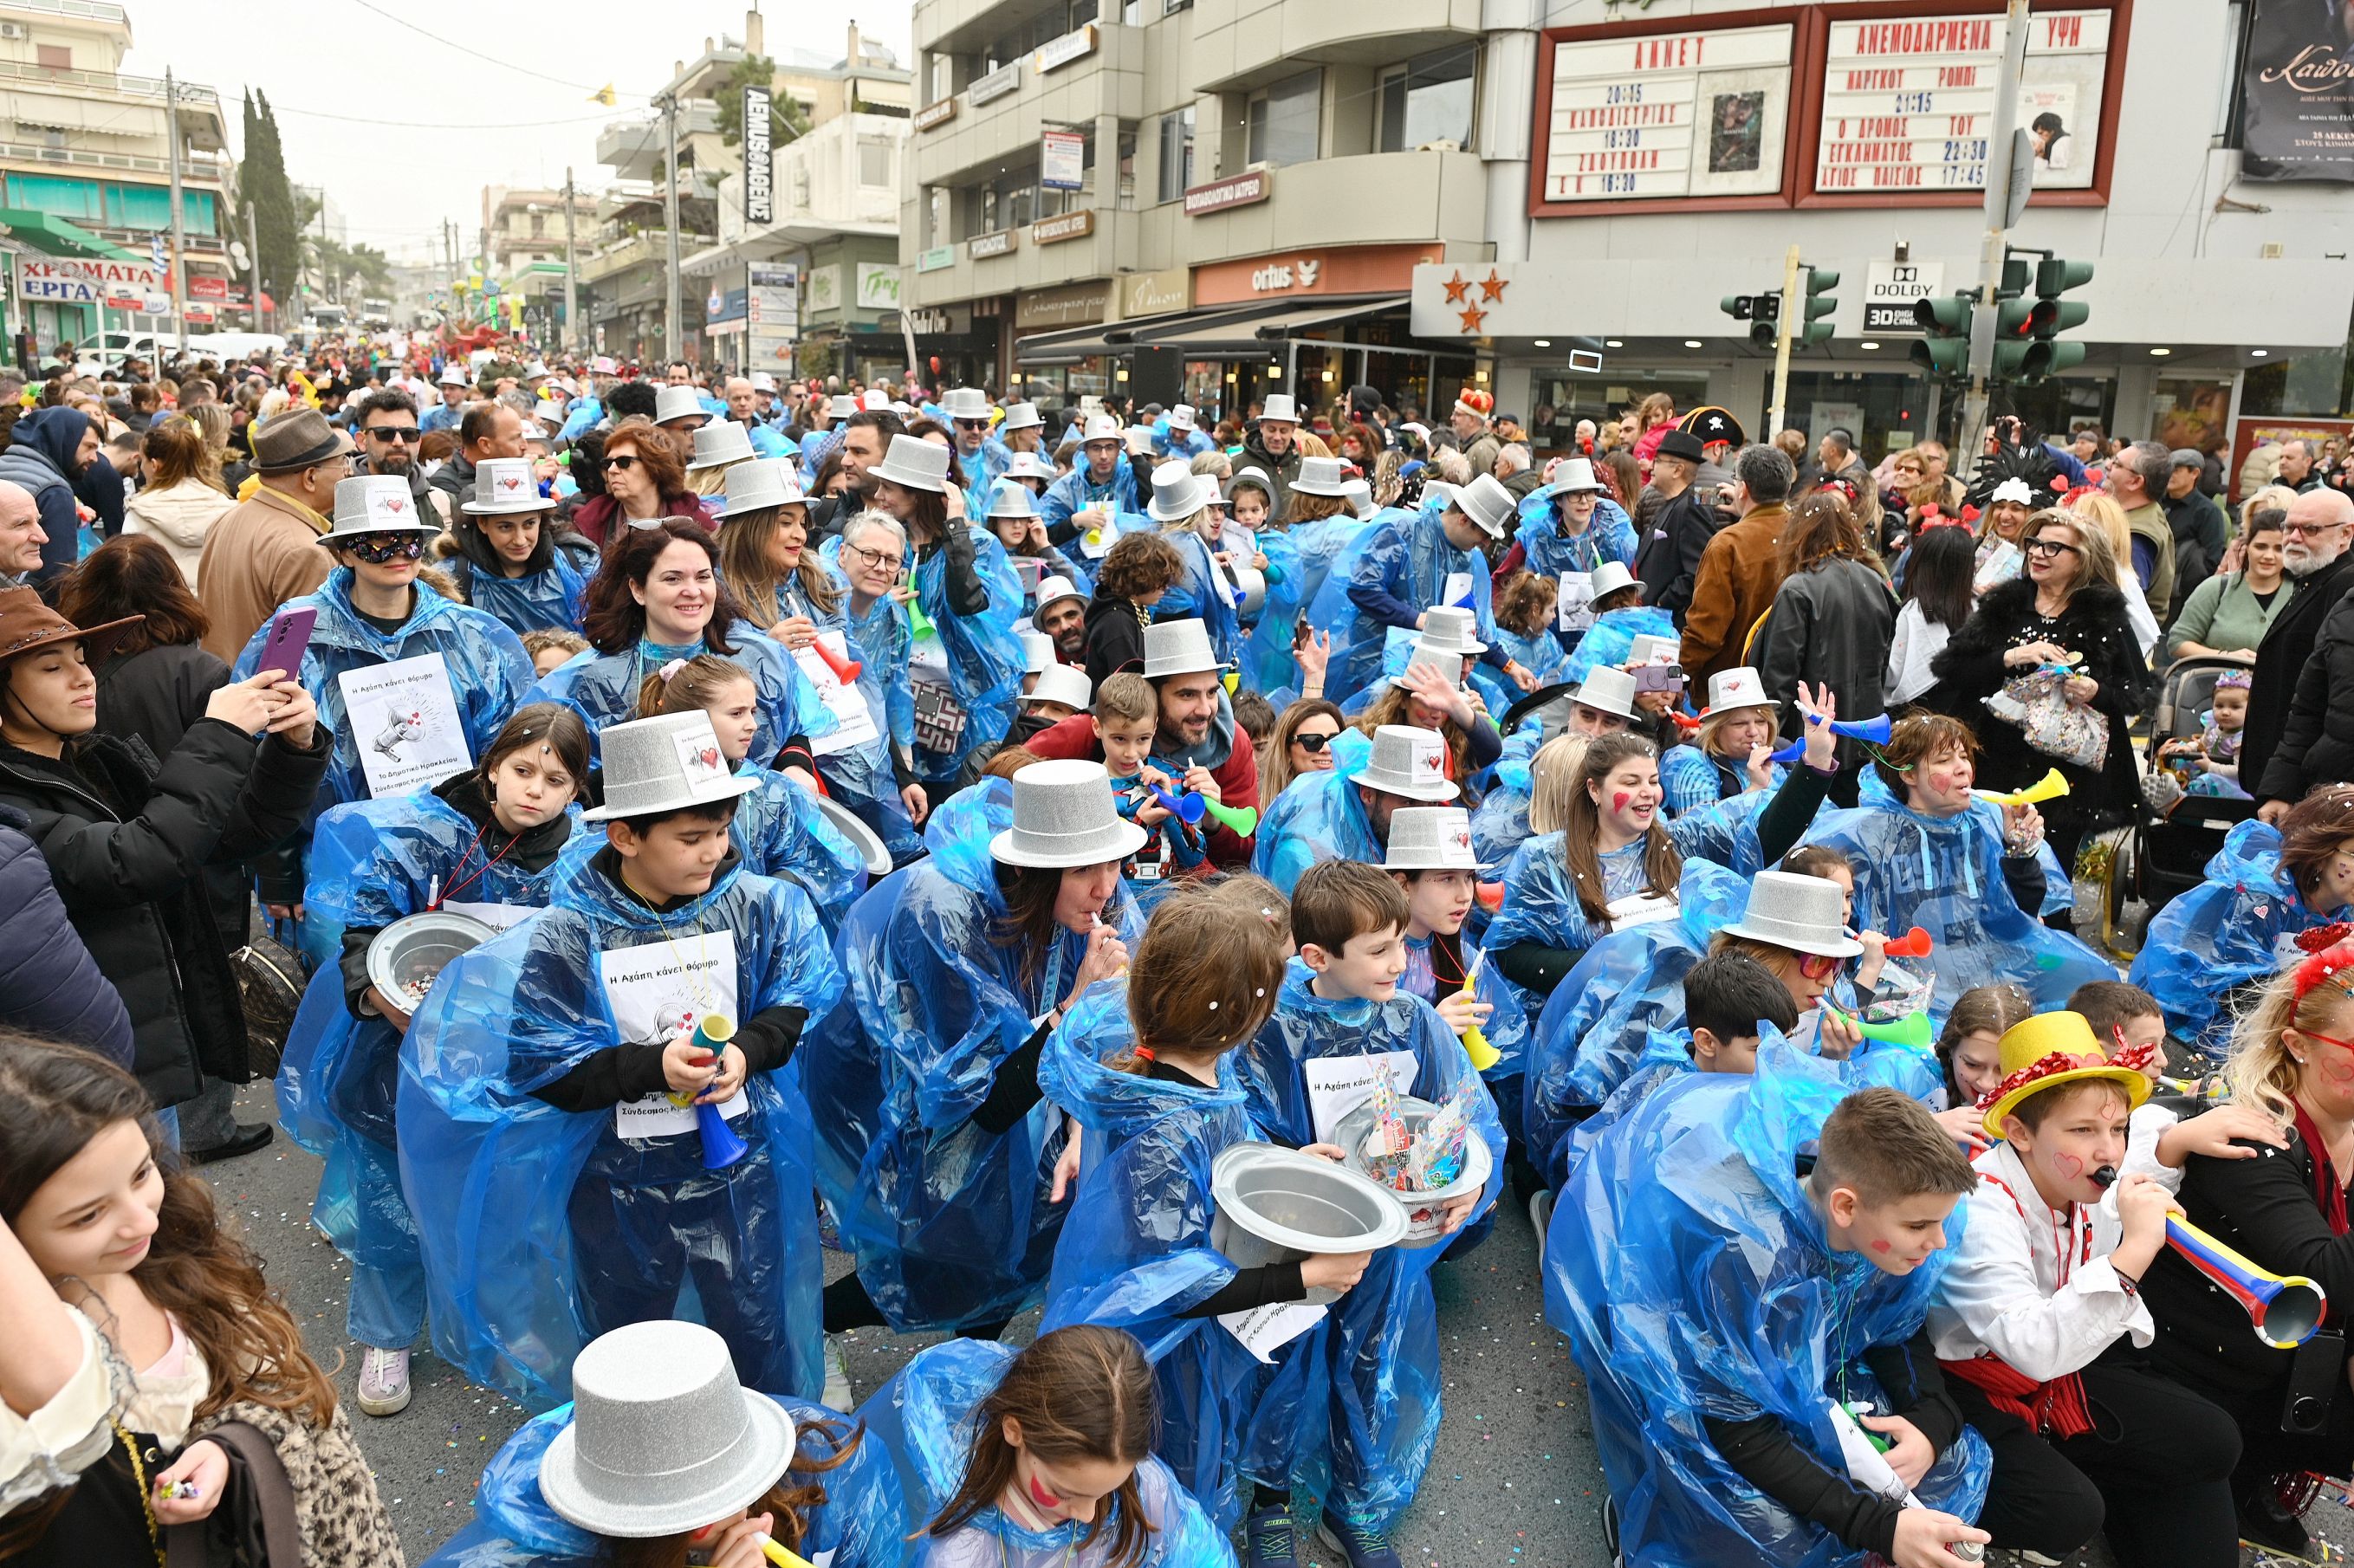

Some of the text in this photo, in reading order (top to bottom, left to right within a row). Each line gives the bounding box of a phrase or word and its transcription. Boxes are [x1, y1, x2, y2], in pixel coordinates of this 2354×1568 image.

[1857, 20, 1991, 55] ΑΝΕΜΟΔΑΡΜΕΝΑ
[2047, 16, 2082, 48] ΥΨΗ
[1607, 84, 1642, 104] 20:15
[1896, 93, 1933, 113] 21:15
[1838, 115, 1974, 139] Ο ΔΡΟΜΟΣ ΤΟΥ
[1605, 129, 1639, 148] 18:30
[1830, 140, 1987, 163] ΕΓΚΛΗΜΑΤΟΣ 22:30
[1821, 165, 1983, 187] ΑΓΙΟΣ ΠΑΙΣΙΟΣ 17:45
[23, 261, 153, 283] ΧΡΩΜΑΤΑ
[1251, 264, 1293, 291] ortus
[1874, 284, 1933, 296] DOLBY
[1869, 309, 1894, 326] 3D
[360, 683, 383, 694] Αγάπη
[386, 678, 405, 688] κάνει
[407, 673, 433, 684] θόρυβο
[387, 766, 419, 778] Δημοτικό
[420, 755, 458, 770] Ηρακλείου
[374, 766, 469, 793] Σύνδεσμος Κρητών Ηρακλείου
[609, 959, 719, 985] Η Αγάπη κάνει θόρυβο
[1324, 1079, 1352, 1092] Αγάπη
[621, 1106, 670, 1117] Σύνδεσμος
